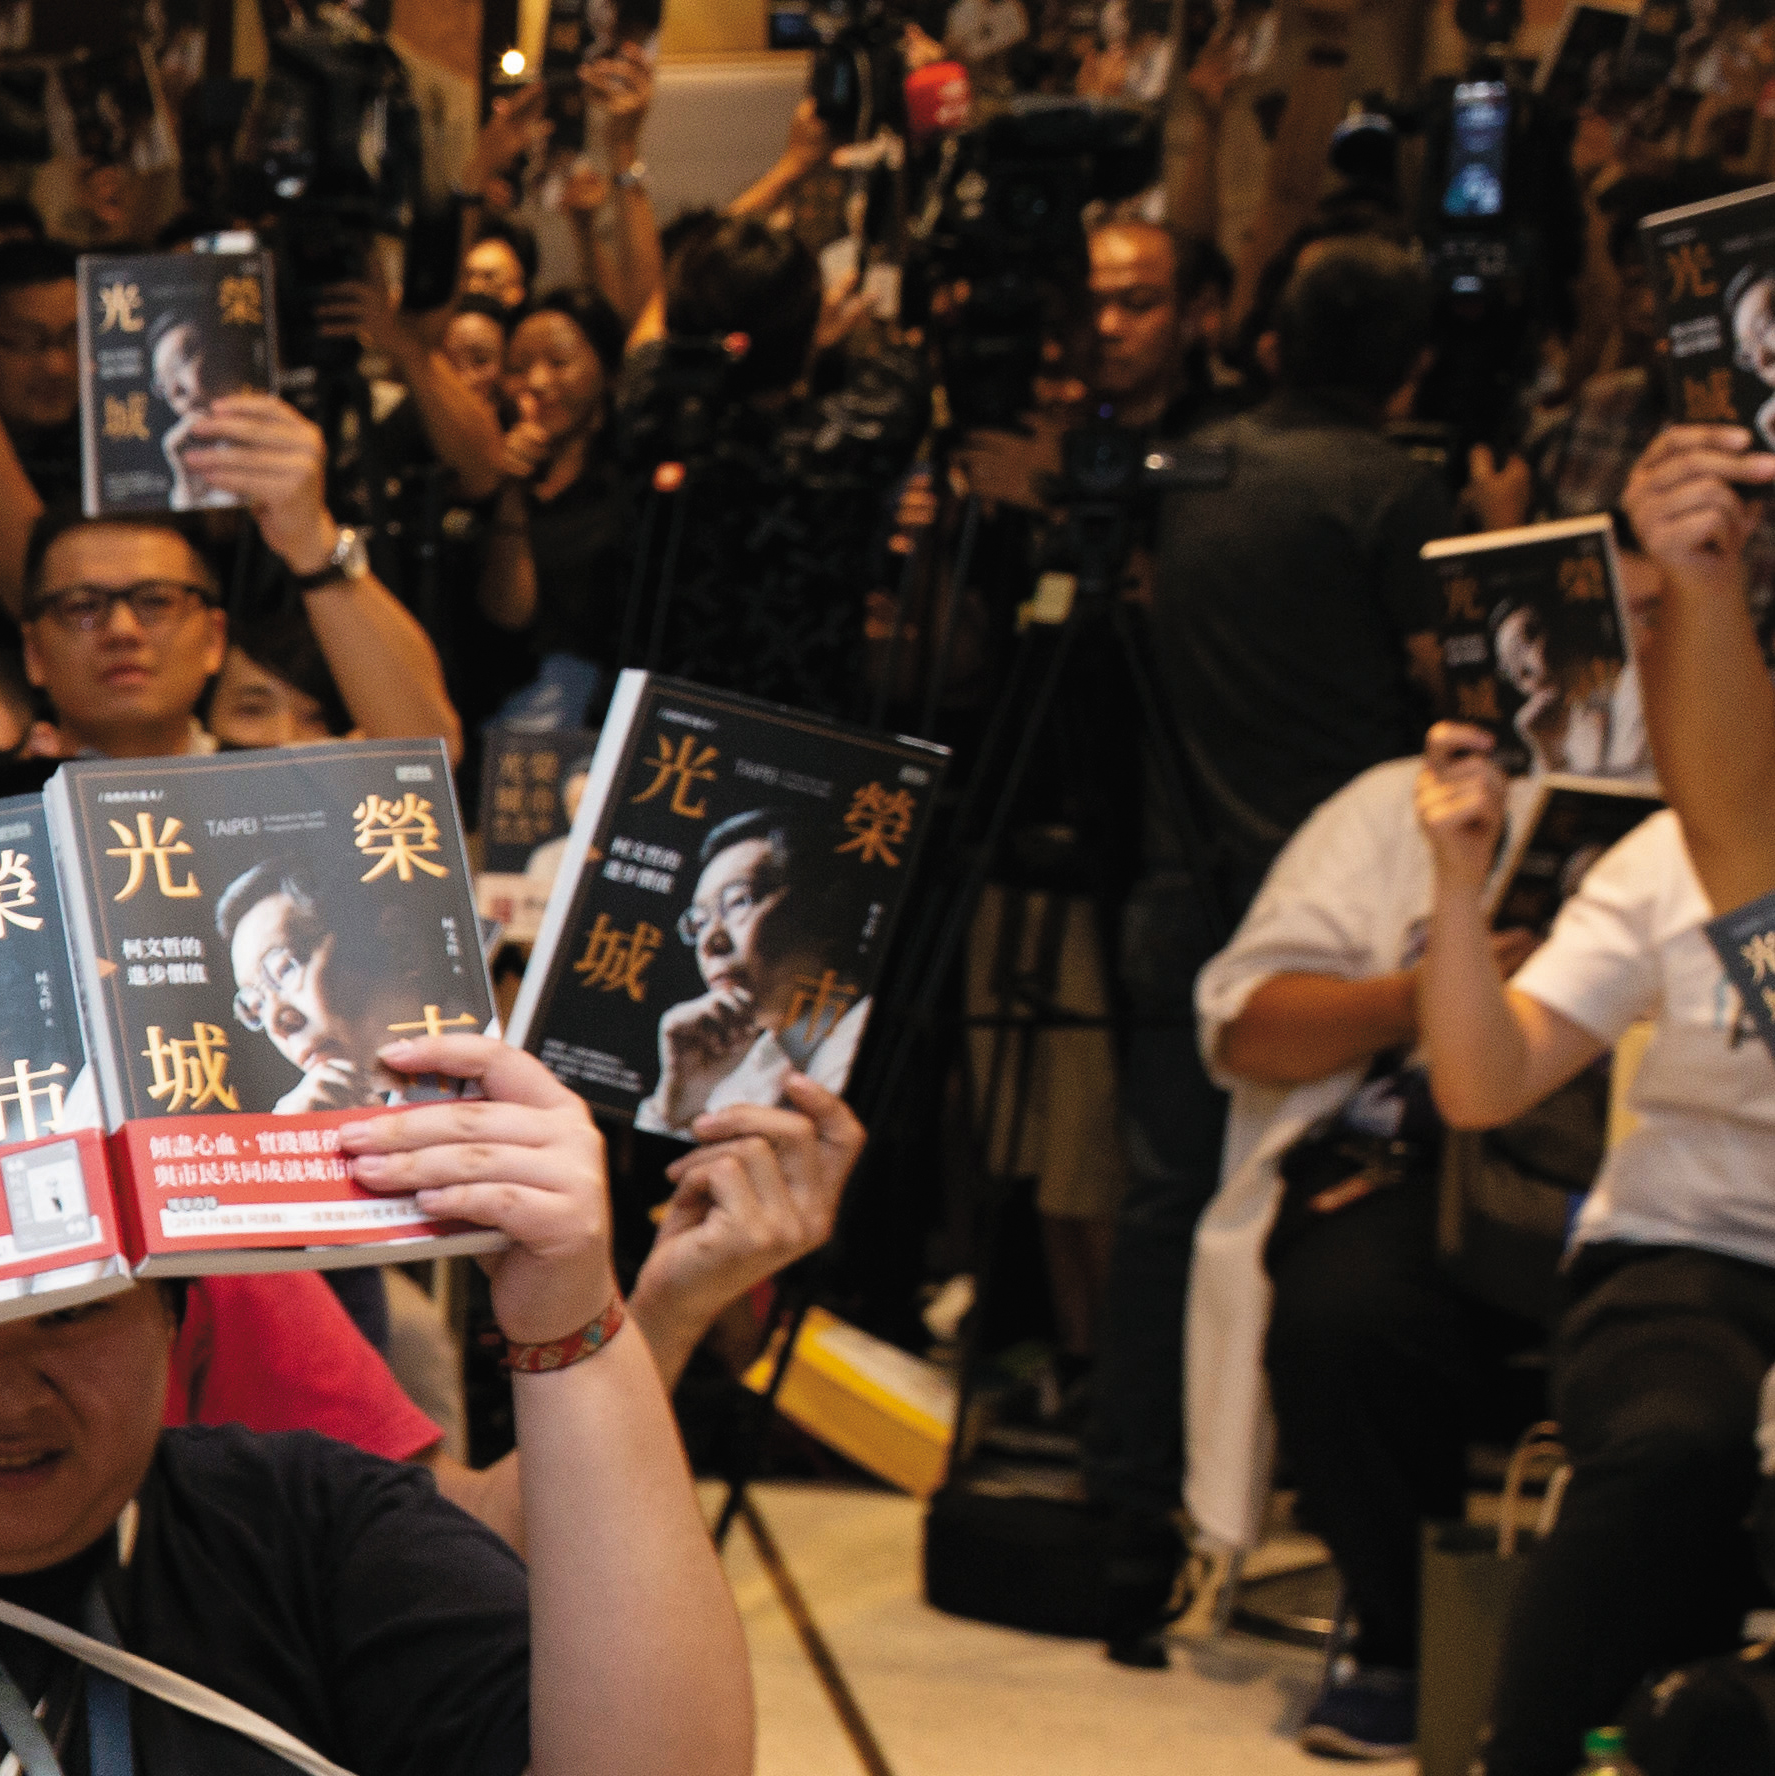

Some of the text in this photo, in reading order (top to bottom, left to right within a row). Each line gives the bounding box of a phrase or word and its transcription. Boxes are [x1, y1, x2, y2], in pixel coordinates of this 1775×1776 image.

[105, 811, 202, 901] 光
[353, 792, 449, 883] 榮
[630, 733, 721, 820] 光
[835, 781, 917, 868] 榮
[572, 912, 664, 1003] 城
[141, 1022, 241, 1112] 城
